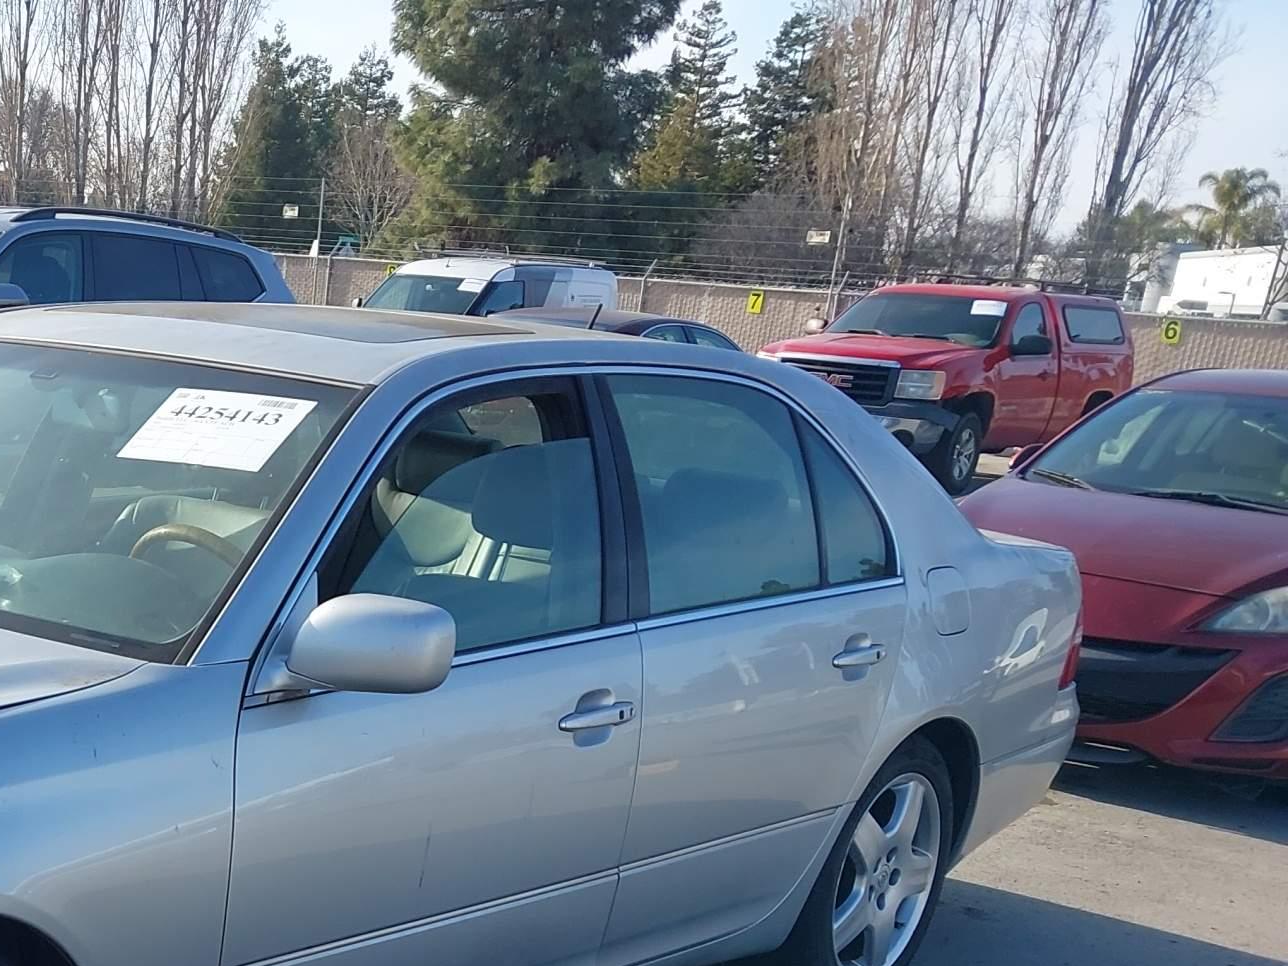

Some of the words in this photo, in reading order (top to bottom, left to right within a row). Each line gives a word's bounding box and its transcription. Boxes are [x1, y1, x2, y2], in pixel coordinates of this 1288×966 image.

[752, 293, 762, 309] 7
[1165, 321, 1178, 339] 6
[170, 404, 283, 426] 44254143
